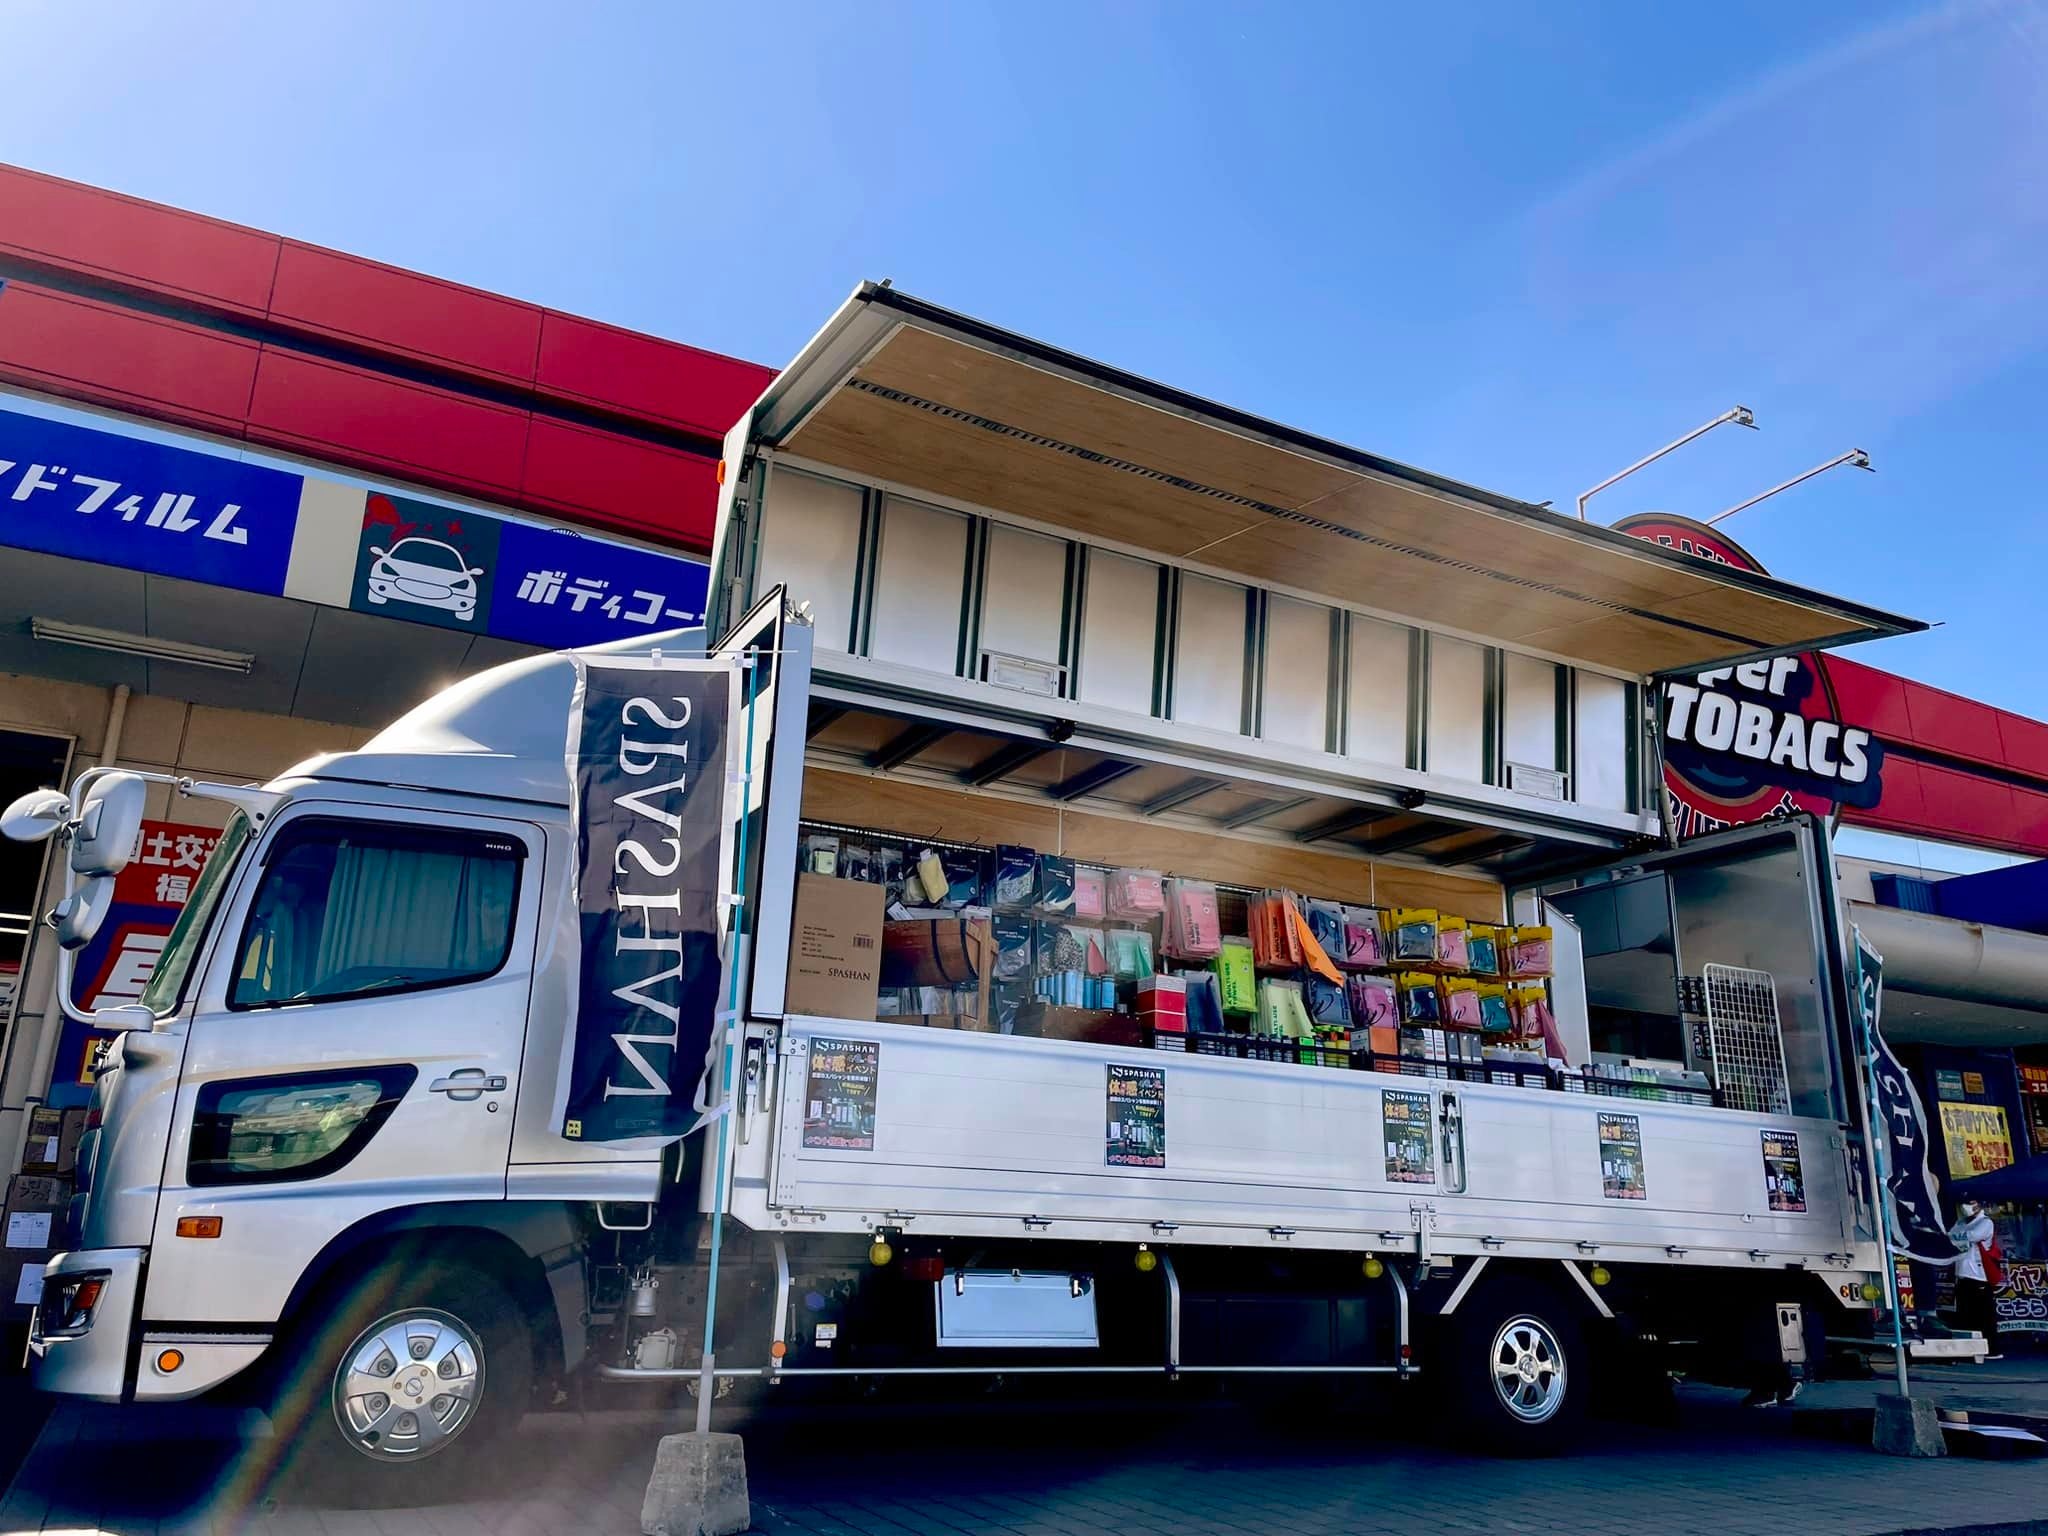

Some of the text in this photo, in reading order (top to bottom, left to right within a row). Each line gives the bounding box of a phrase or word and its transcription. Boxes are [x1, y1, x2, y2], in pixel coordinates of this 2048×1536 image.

[516, 570, 706, 625] ボディコー
[1663, 682, 1873, 784] TOBACS
[485, 843, 512, 851] HINO
[827, 967, 871, 981] SPASHAN
[830, 1043, 875, 1054] SPASHAN
